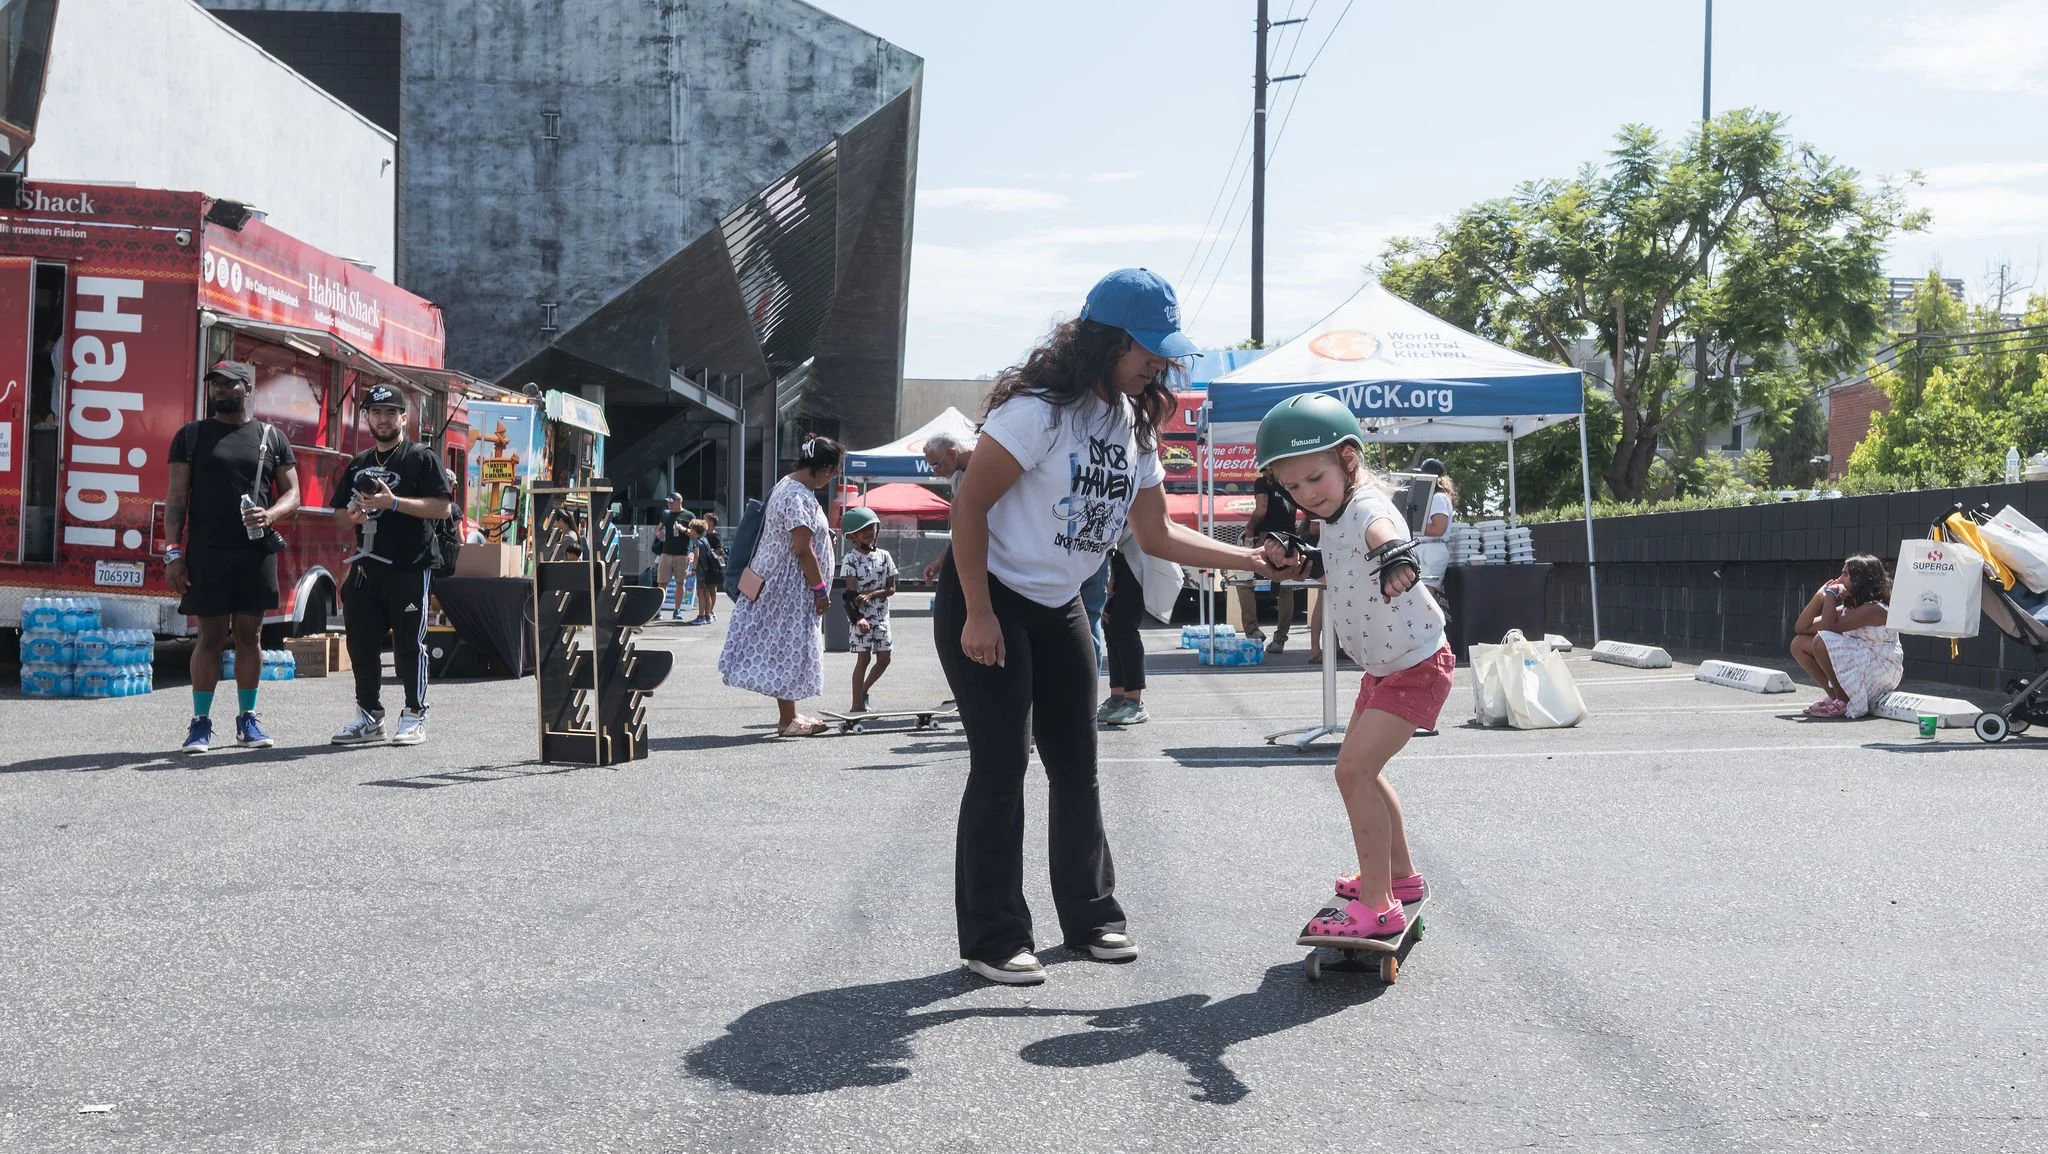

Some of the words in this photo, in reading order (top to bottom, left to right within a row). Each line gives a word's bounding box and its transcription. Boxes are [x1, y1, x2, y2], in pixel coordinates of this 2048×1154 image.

[19, 189, 95, 214] Shack
[54, 228, 87, 239] Fusion
[308, 273, 347, 315] Habibi
[349, 290, 379, 328] Shack
[1386, 331, 1440, 340] World
[1392, 341, 1459, 349] Central
[1394, 350, 1467, 358] Kitchen
[1338, 384, 1453, 413] WCK.org
[64, 276, 147, 550] Habibi
[1291, 436, 1321, 447] thousand
[1089, 435, 1129, 470] SK8
[1200, 444, 1225, 455] Hme
[1228, 446, 1237, 455] of
[1238, 446, 1251, 456] The
[1072, 463, 1134, 502] HAVEN
[1912, 562, 1955, 571] SUPERGA
[98, 570, 141, 583] 70659T3
